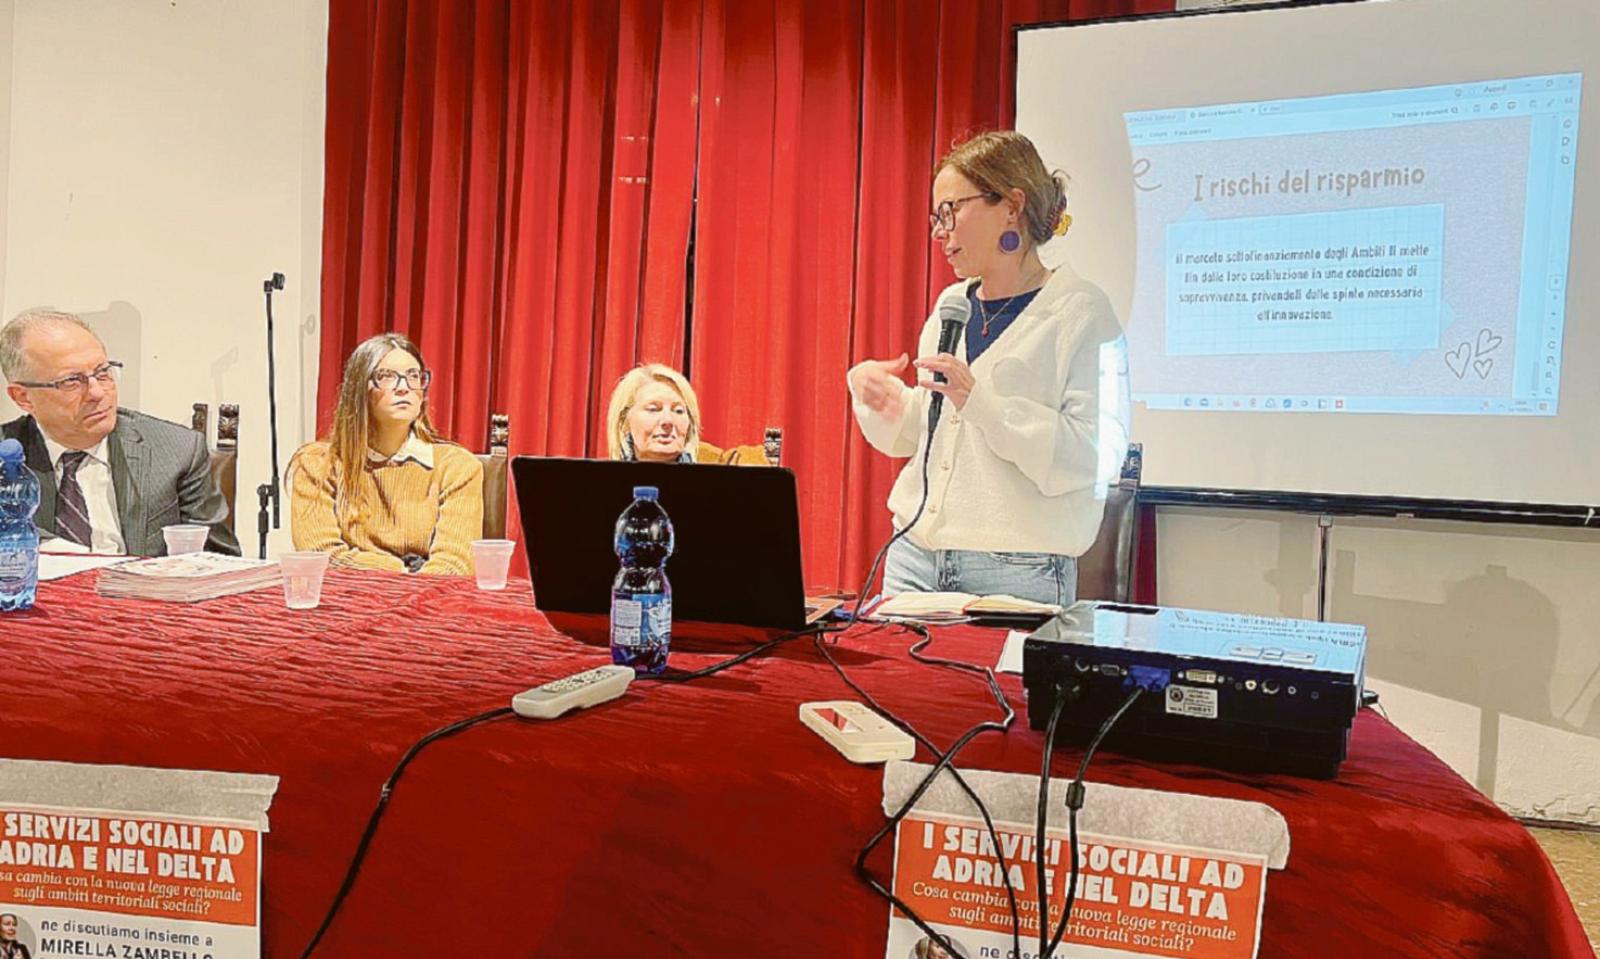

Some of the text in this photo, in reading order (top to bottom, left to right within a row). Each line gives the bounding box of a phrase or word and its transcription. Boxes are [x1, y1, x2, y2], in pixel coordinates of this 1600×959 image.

[1194, 167, 1425, 201] I rischi del risparmio
[1351, 244, 1385, 258] Ambiti
[1400, 244, 1429, 256] mette
[1227, 269, 1247, 282] loro
[1250, 268, 1308, 281] costituzione
[1312, 268, 1322, 279] in
[1325, 269, 1343, 279] una
[1346, 265, 1403, 279] condizione
[1407, 265, 1417, 277] di
[4, 812, 245, 855] SERVIZI SOCIALI AD
[0, 839, 236, 883] ADRIA E NEL DELTA
[923, 821, 934, 849] I
[1199, 859, 1245, 889] AD
[14, 885, 211, 915] sugli ambiti territoriali sociali?
[16, 871, 61, 884] cambia
[65, 874, 88, 886] con
[91, 874, 103, 888] la
[106, 881, 145, 893] nuova
[148, 877, 180, 898] legge
[184, 885, 243, 902] regionale
[932, 854, 1025, 892] ADRIA
[1129, 880, 1229, 921] DELTA
[912, 881, 949, 899] Cosa
[953, 889, 1008, 907] cambia
[1047, 899, 1059, 916] a
[1117, 909, 1157, 932] legge
[1161, 918, 1237, 941] regionale
[41, 919, 213, 947] ne discutiamo insieme a
[949, 904, 986, 924] sugli
[1133, 932, 1194, 951] sociali?
[41, 937, 117, 958] MIRELLA
[980, 946, 1000, 959] ne
